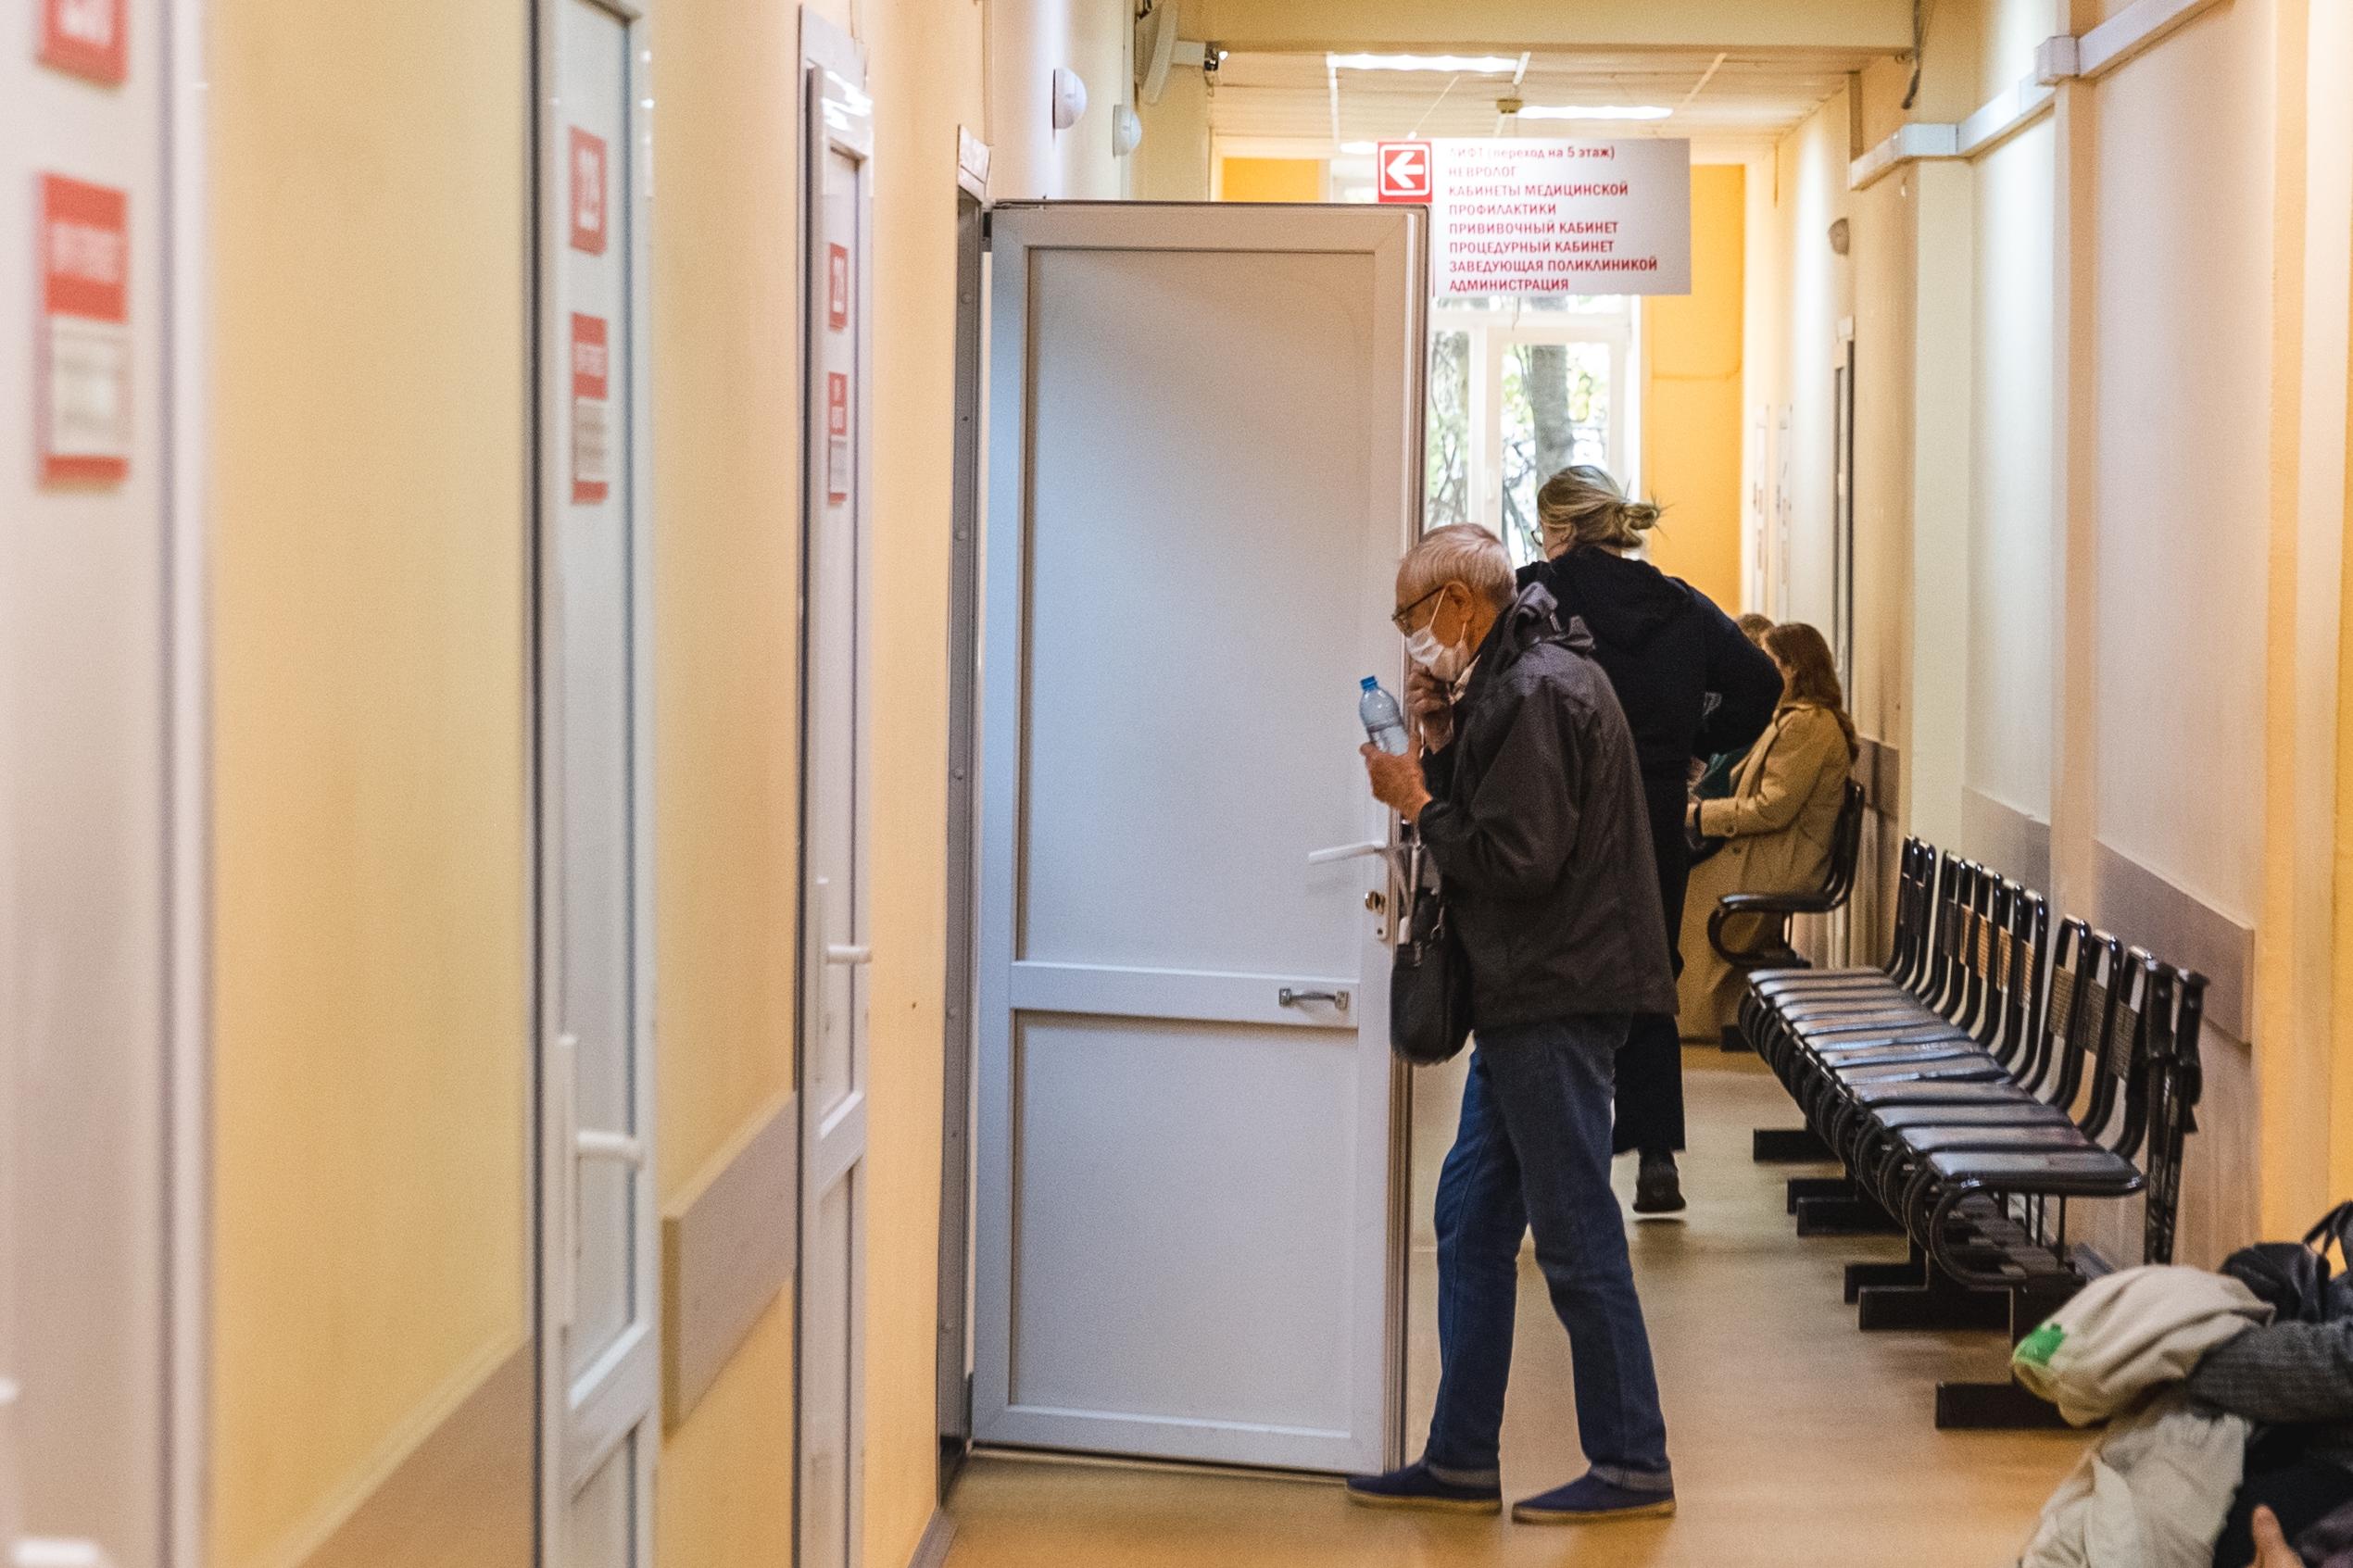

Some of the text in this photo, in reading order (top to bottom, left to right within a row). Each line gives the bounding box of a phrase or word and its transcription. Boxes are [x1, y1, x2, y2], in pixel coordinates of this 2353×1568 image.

[1548, 148, 1564, 158] на
[1567, 145, 1575, 158] 5
[1579, 145, 1616, 160] этаж)
[1449, 166, 1517, 178] НЕВРОЛОГ
[1449, 181, 1629, 197] КАБИНЕТЫ МЕДИЦИНСКОЙ
[1449, 203, 1556, 215] ПРОФИЛАКТИКИ
[1449, 220, 1618, 234] ПРИВИВОЧНЫЙ КАБИНЕТ
[1449, 239, 1615, 255] ПРОЦЕДУРНЫЙ КАБИНЕТ
[1449, 256, 1658, 273] ЗАВЕДУЮЩАЯ ПОЛИКЛИНИКОЙ
[1449, 278, 1569, 293] АДМИНИСТРАЦИЯ
